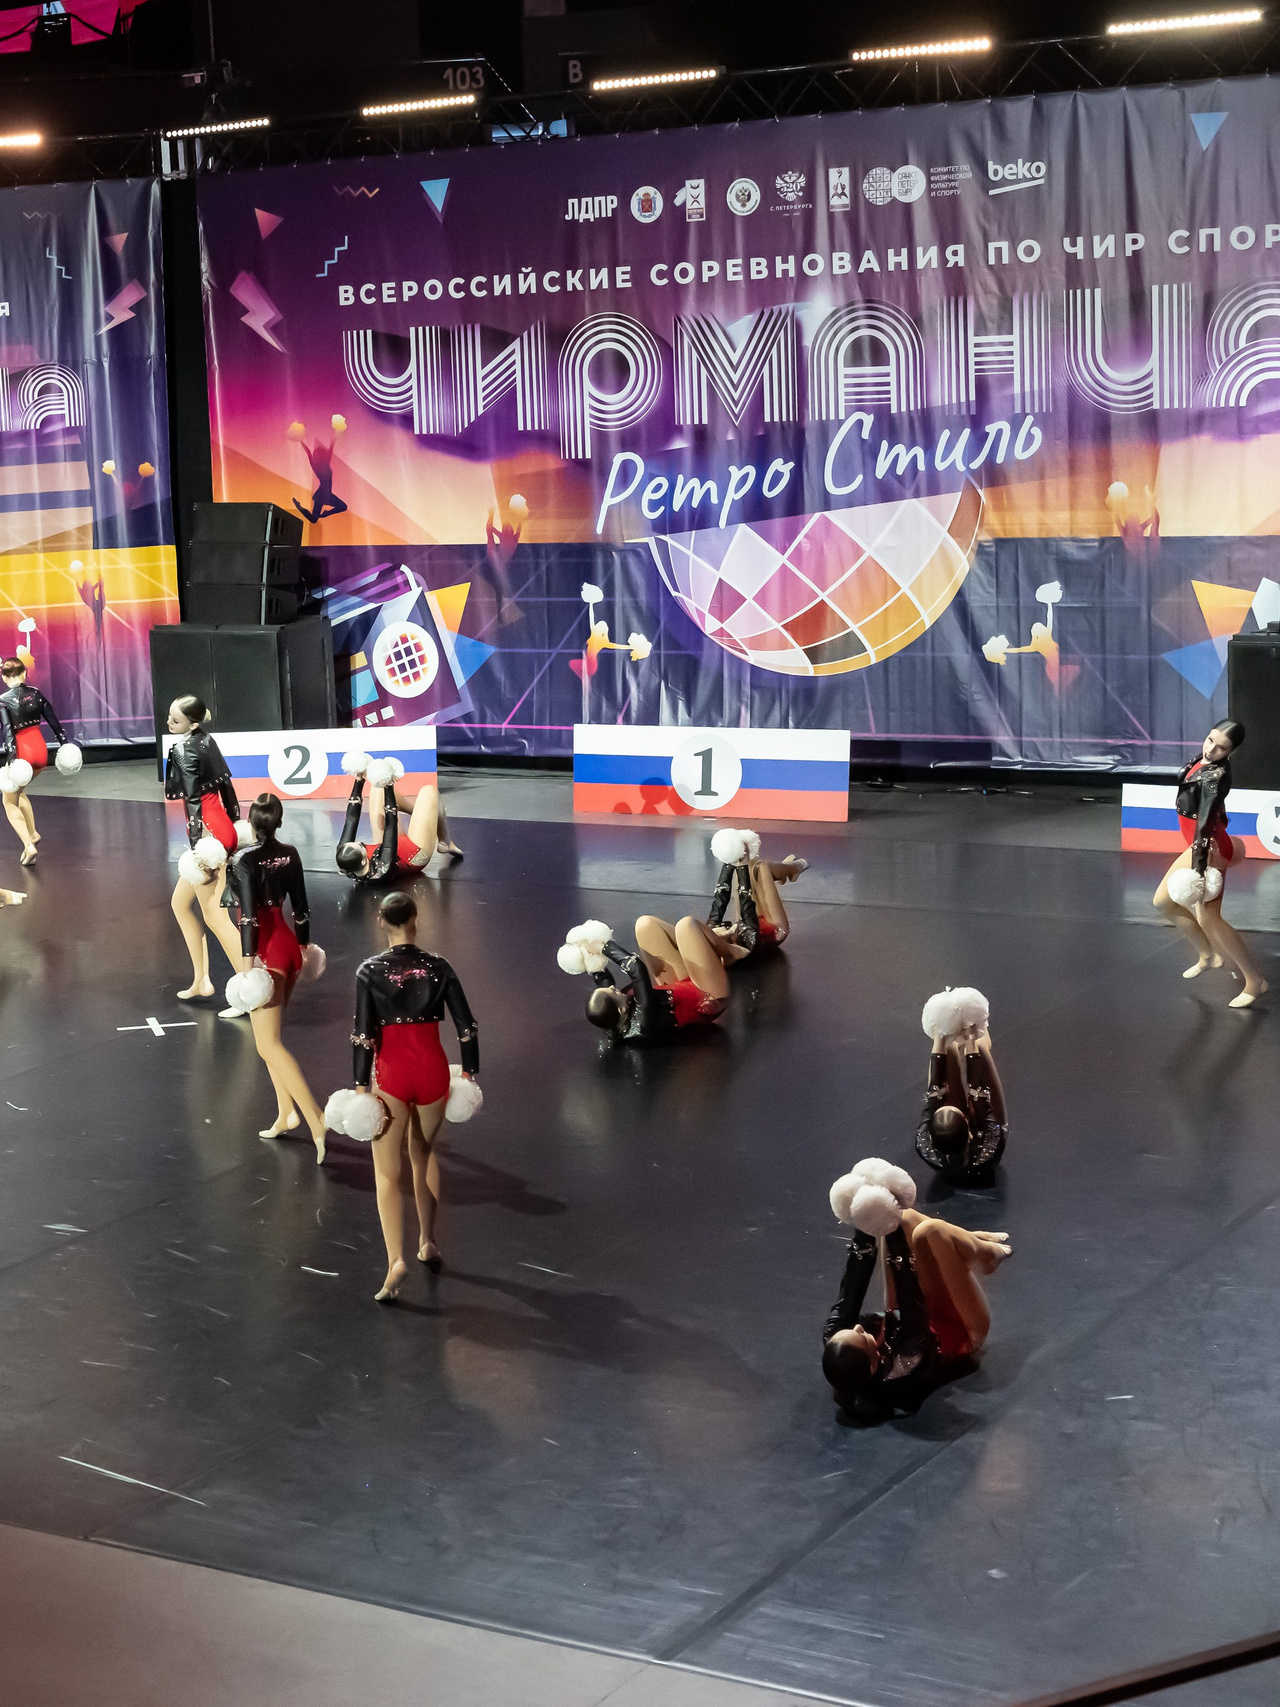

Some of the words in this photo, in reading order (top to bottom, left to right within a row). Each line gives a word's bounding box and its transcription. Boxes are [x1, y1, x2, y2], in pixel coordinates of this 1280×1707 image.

[443, 66, 485, 91] 103
[930, 165, 959, 173] КОМИТЕТ
[987, 158, 1046, 182] beko
[936, 189, 961, 197] СПОРТУ
[564, 195, 618, 223] ЛДПР
[338, 265, 633, 306] ВСЕРОССИЙСКИЕ
[650, 243, 965, 286] СОРЕВНОВАНИЯ
[987, 239, 1042, 266] ПО
[1062, 232, 1146, 260] ЧИР
[595, 451, 795, 535] Ретро
[823, 411, 1043, 496] Стиль
[283, 745, 312, 785] 2
[693, 747, 719, 797] 1
